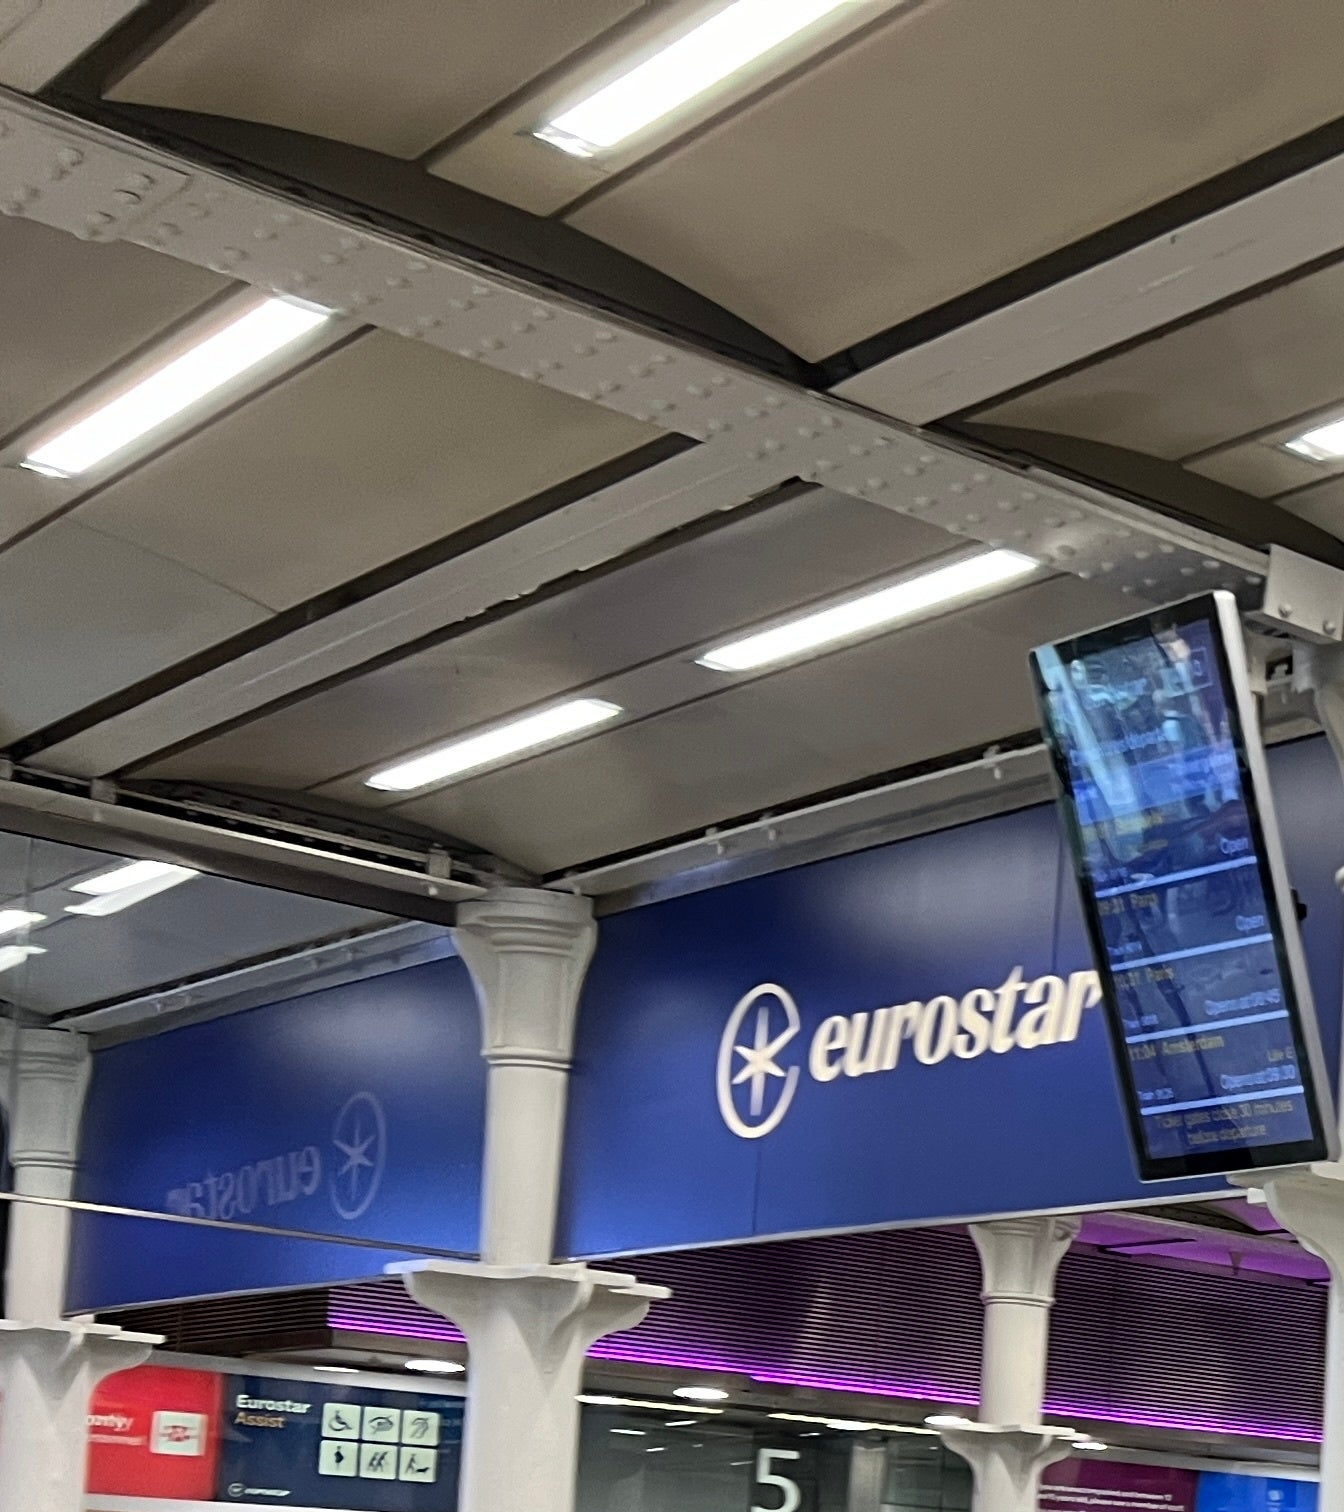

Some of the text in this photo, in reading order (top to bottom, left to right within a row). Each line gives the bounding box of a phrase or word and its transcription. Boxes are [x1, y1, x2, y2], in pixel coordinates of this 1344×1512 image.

[808, 965, 1101, 1083] eurostar
[235, 1394, 313, 1414] Eurostar
[233, 1410, 287, 1429] Assist
